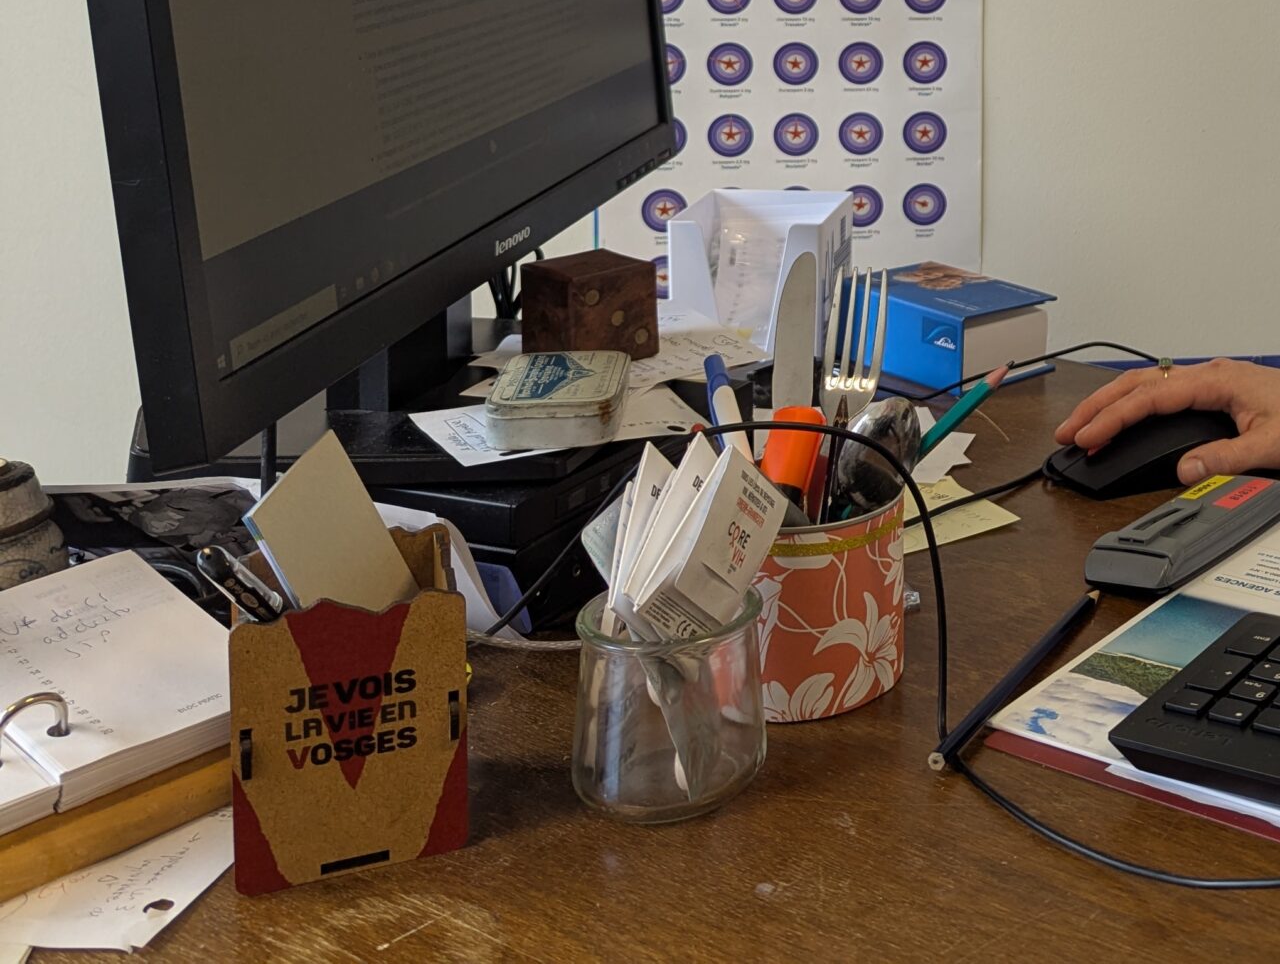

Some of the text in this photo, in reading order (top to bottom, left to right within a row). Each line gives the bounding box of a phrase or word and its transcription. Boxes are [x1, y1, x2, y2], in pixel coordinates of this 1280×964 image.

[495, 226, 531, 256] lenovo
[934, 336, 957, 350] Linde
[1214, 575, 1272, 596] AGENCES
[284, 669, 416, 714] JE VOIS
[1253, 690, 1267, 698] 9
[285, 718, 322, 742] LA
[325, 707, 373, 733] VIE
[286, 726, 417, 770] VOSGES
